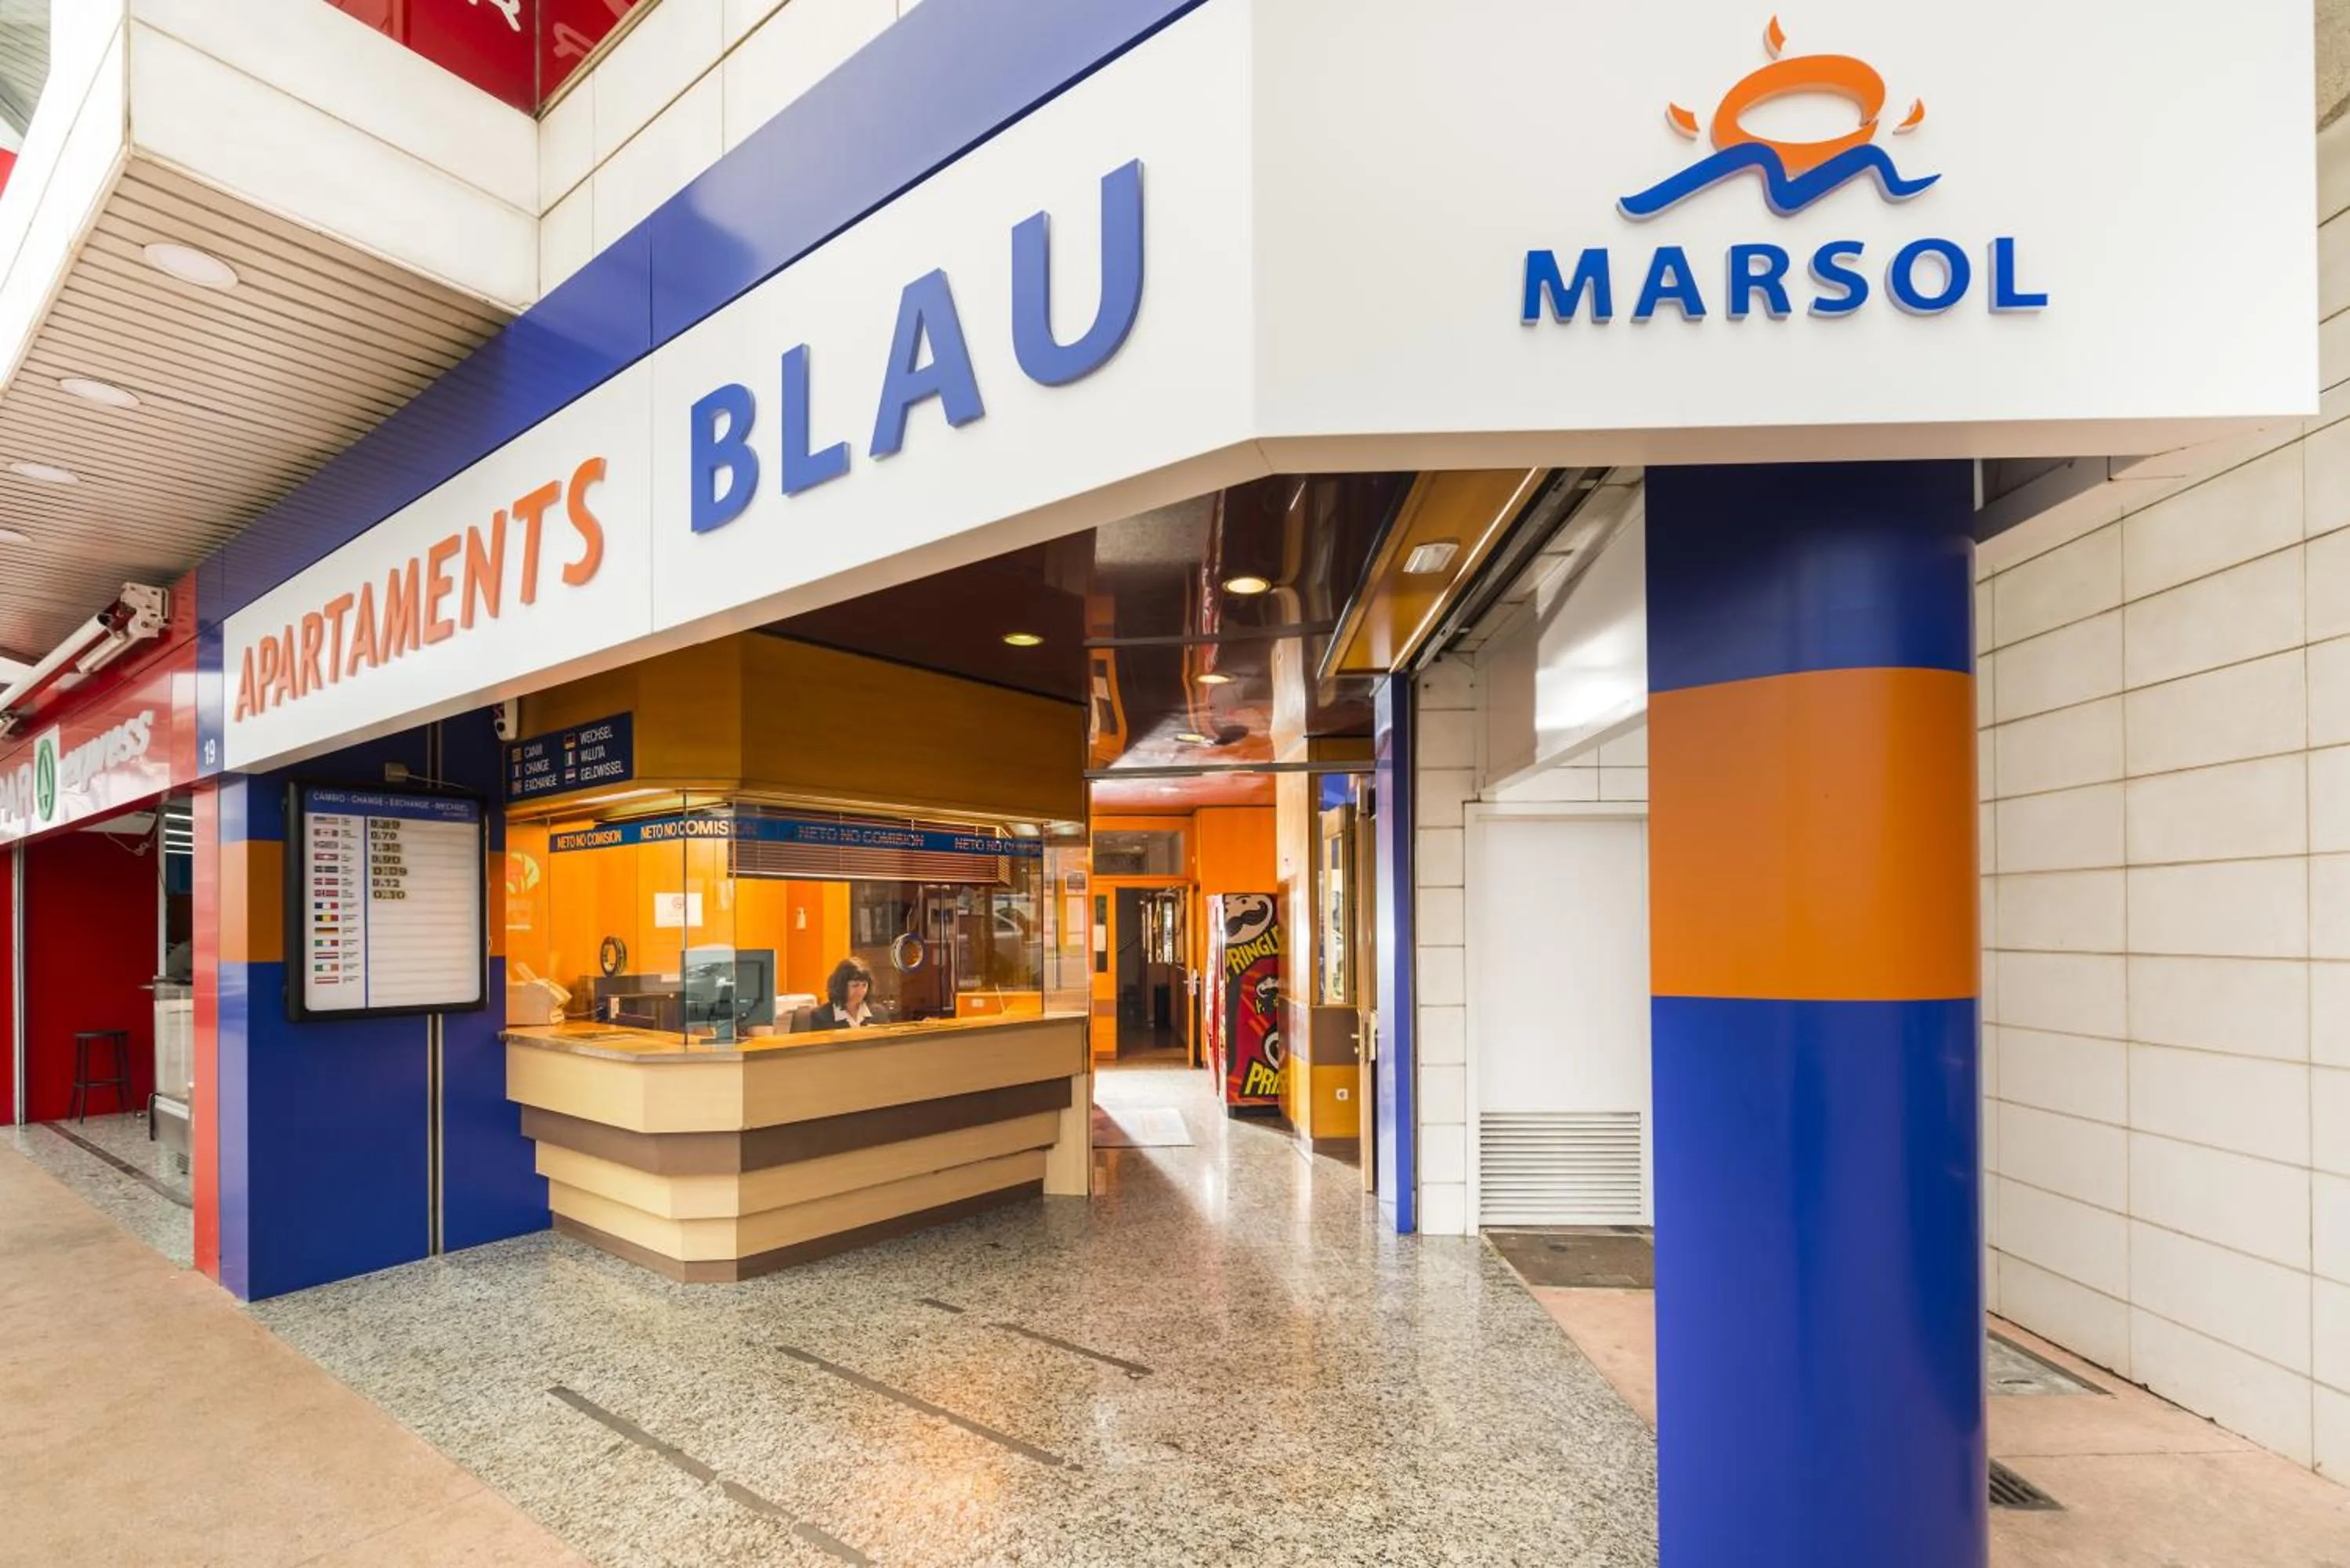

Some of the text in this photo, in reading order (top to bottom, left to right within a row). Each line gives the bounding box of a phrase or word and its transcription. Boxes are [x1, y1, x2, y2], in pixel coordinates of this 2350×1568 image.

[1520, 237, 2048, 325] MARSOL
[234, 157, 1145, 723] APARTAMENTS BLAU
[579, 725, 613, 744] WECHSEL
[204, 739, 216, 764] 19
[580, 745, 606, 761] VALUTA
[525, 758, 550, 775] CHANGE
[580, 761, 624, 781] GELDWISSEL
[525, 773, 558, 791] EXCHANGE
[352, 794, 383, 806] CHANGE
[640, 823, 662, 840] NETO
[664, 822, 677, 837] NO
[797, 826, 837, 841] NETO
[840, 827, 860, 842] NO
[557, 835, 575, 850] NETO
[576, 833, 586, 847] NO
[954, 836, 985, 851] NETO
[986, 840, 1002, 852] NO
